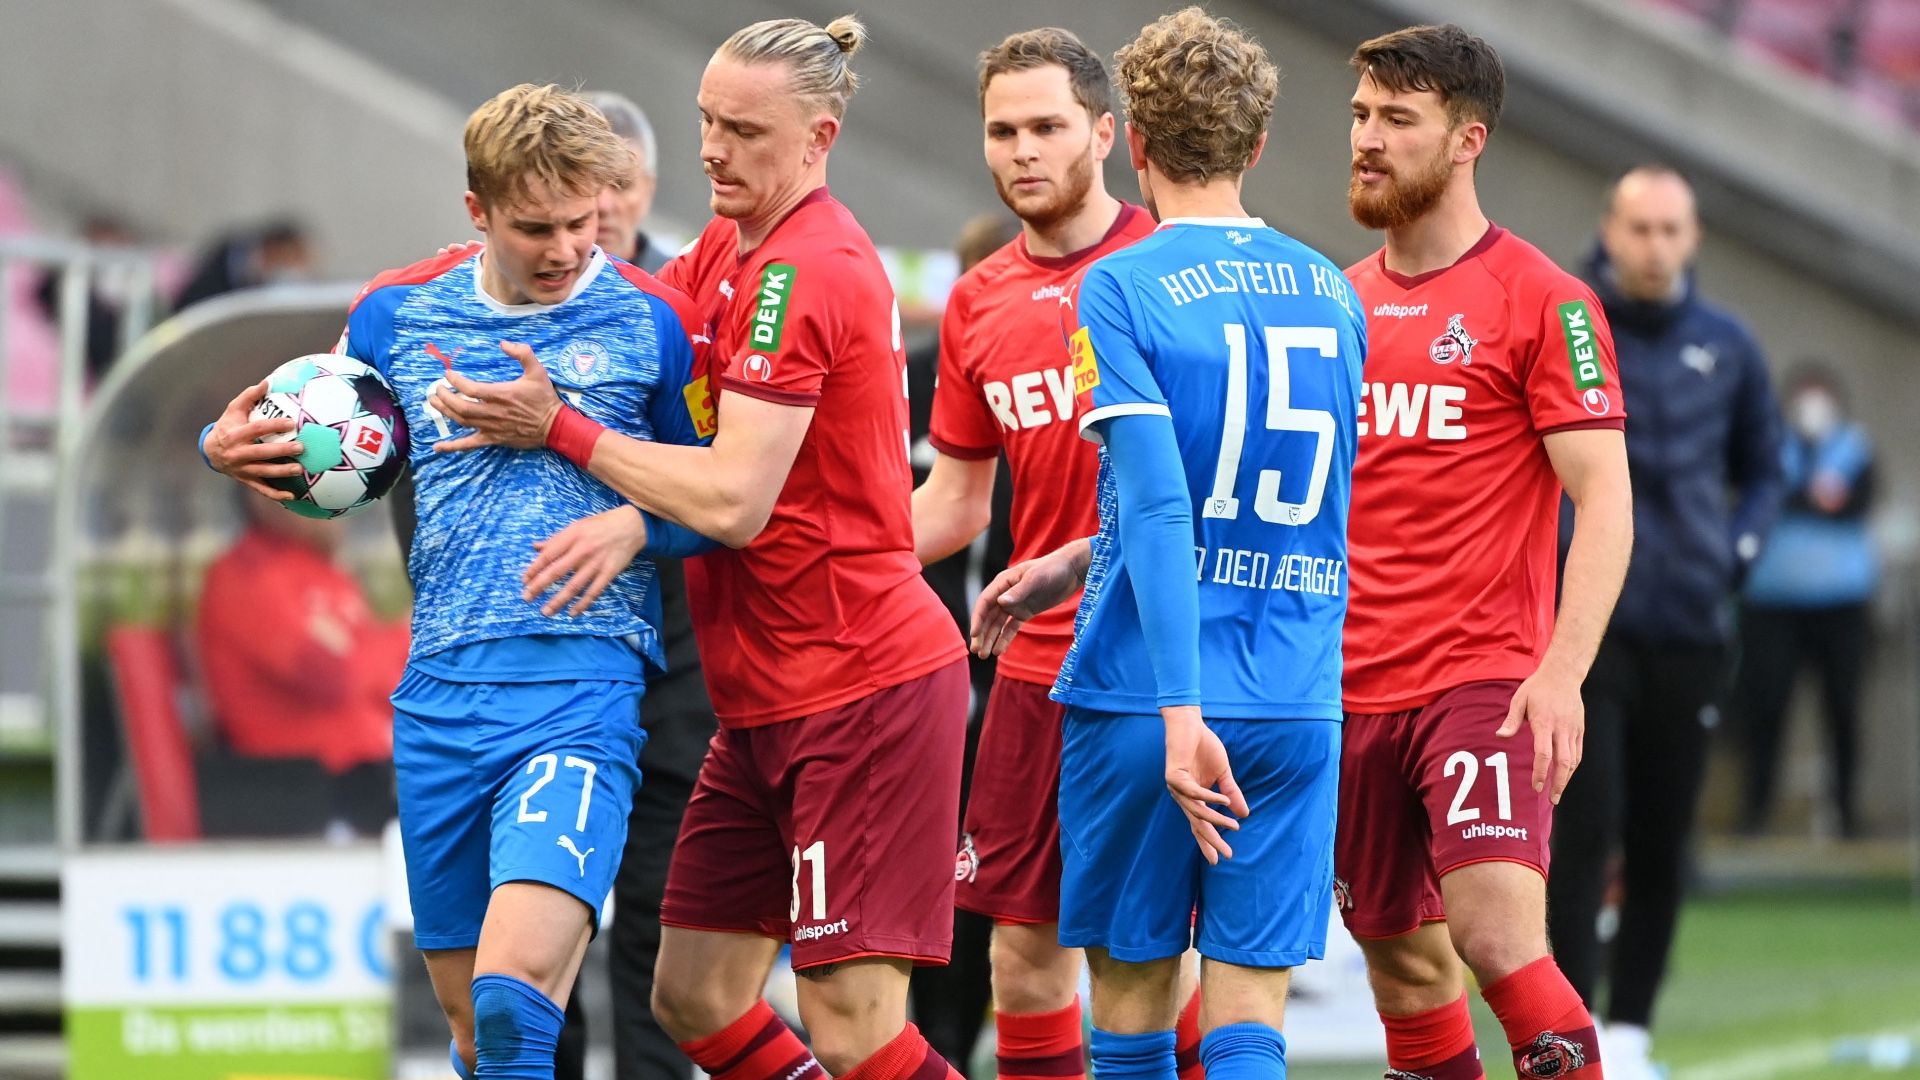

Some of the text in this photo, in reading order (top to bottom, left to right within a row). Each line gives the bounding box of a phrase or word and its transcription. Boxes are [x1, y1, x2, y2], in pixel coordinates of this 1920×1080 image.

[754, 271, 788, 345] DEVK
[1031, 284, 1065, 301] uhls
[1158, 260, 1354, 318] HOLSTEIN KIEL
[1373, 303, 1429, 320] uhlsport
[1566, 308, 1597, 381] DEVK
[1202, 322, 1339, 527] 15
[1213, 547, 1270, 590] DEN
[1271, 553, 1343, 597] BERGH
[516, 752, 597, 833] 27
[1443, 750, 1512, 827] 21
[1462, 822, 1528, 841] uhlsport
[790, 840, 826, 924] 31
[122, 900, 191, 984] 11
[217, 899, 334, 986] 88
[794, 918, 849, 942] uhlsport
